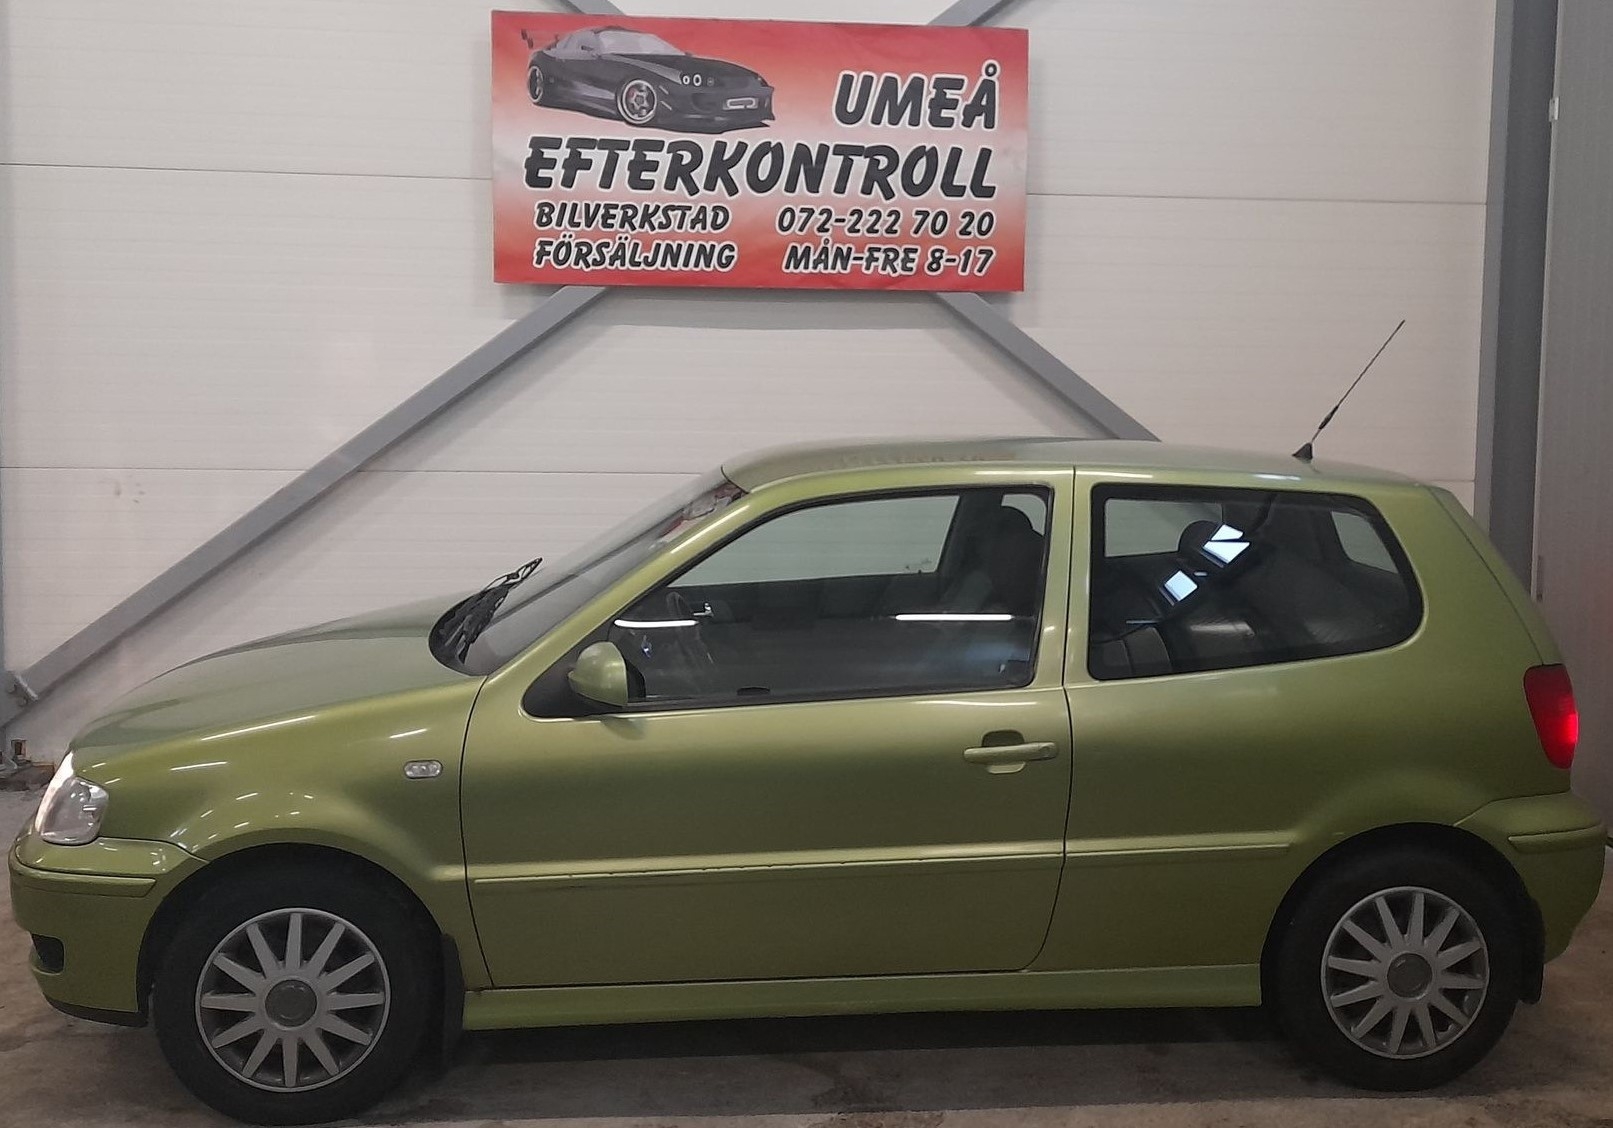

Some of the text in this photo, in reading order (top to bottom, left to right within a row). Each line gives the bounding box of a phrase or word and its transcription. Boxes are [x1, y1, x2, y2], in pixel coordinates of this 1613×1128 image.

[835, 62, 997, 129] UMEÅ
[524, 136, 997, 199] EFTERKONTROLL
[535, 201, 730, 232] BILVERKSTAD
[777, 207, 995, 236] 072-222 70 20
[534, 234, 736, 270] FÖRSÄLJNING
[784, 238, 994, 275] MÅN-FRE 8-17
